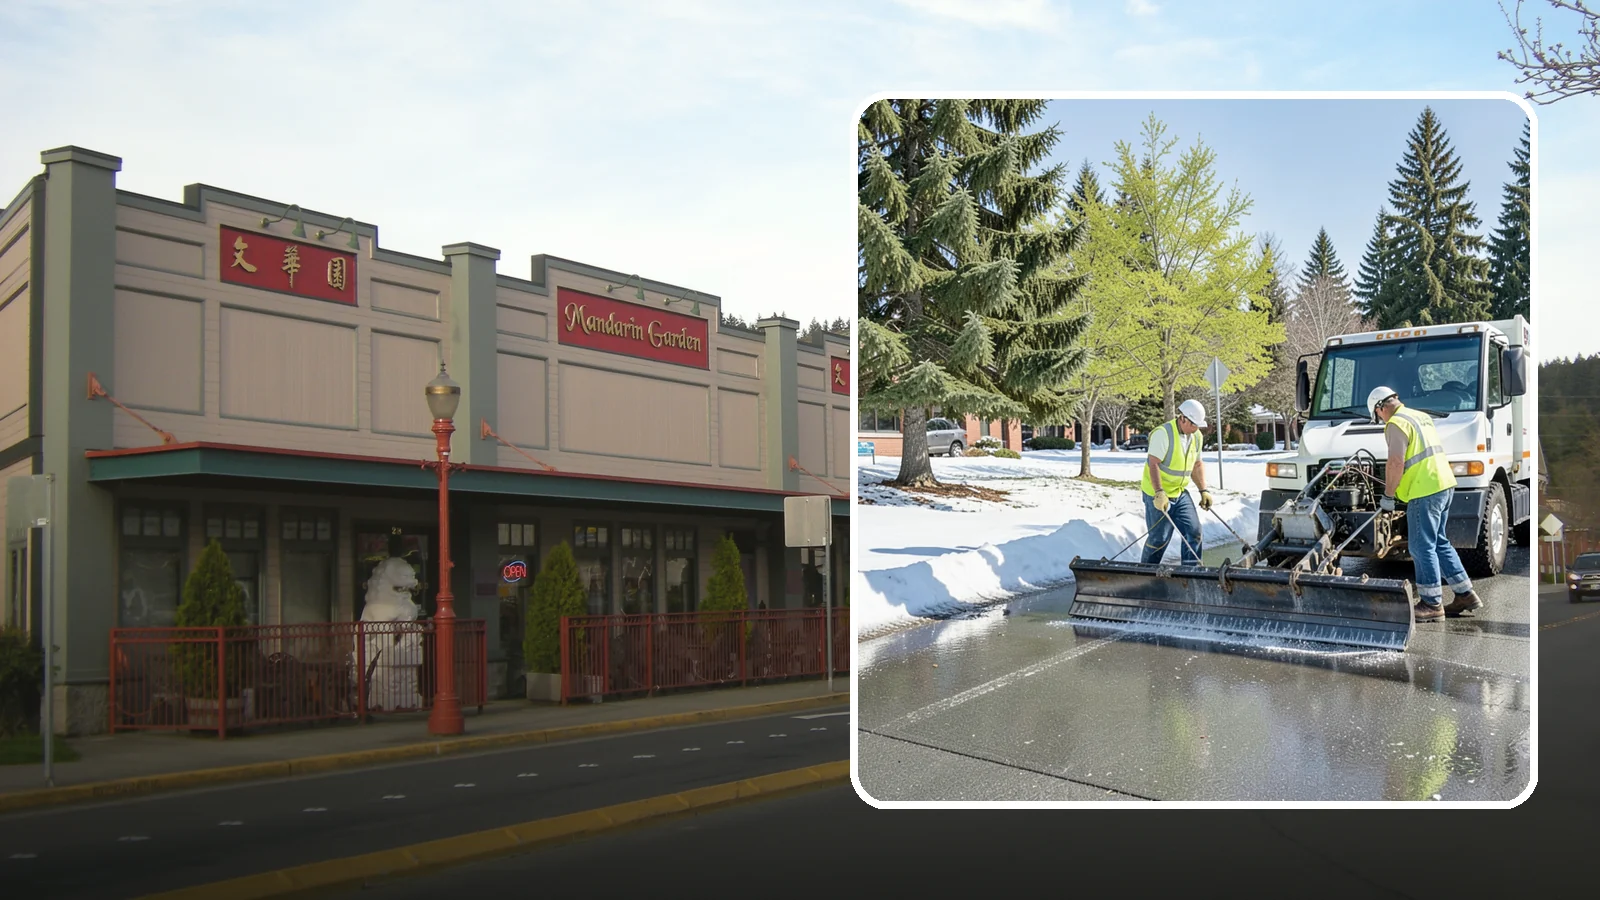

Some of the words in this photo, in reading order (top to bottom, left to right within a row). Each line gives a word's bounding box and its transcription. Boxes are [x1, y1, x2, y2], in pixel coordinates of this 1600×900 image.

[565, 303, 644, 341] Mandarin
[648, 321, 701, 352] Garden
[503, 565, 527, 578] OPEN
